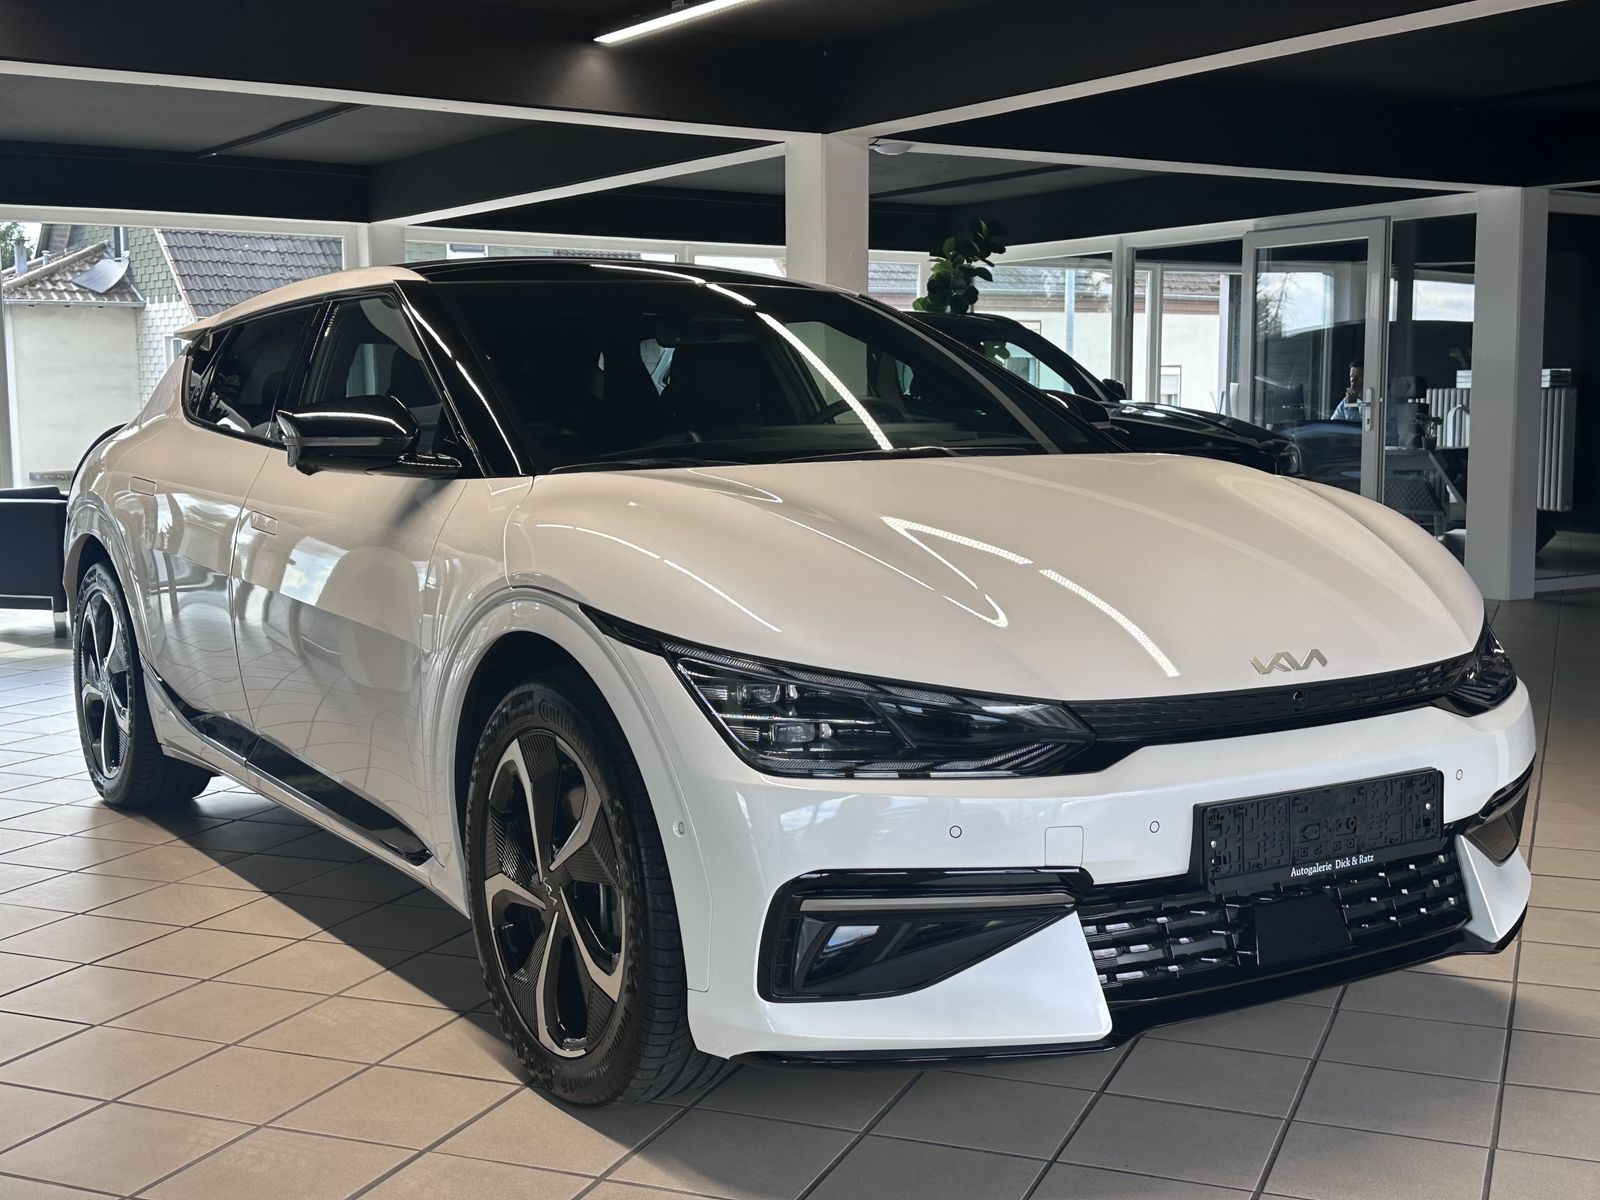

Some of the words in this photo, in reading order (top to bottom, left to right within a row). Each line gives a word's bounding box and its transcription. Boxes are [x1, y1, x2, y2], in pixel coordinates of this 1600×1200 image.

[1250, 648, 1328, 675] KIA
[1290, 861, 1333, 877] Autogalerie
[1335, 857, 1351, 869] Dick
[1351, 856, 1358, 866] &
[1359, 854, 1374, 864] Ratz
